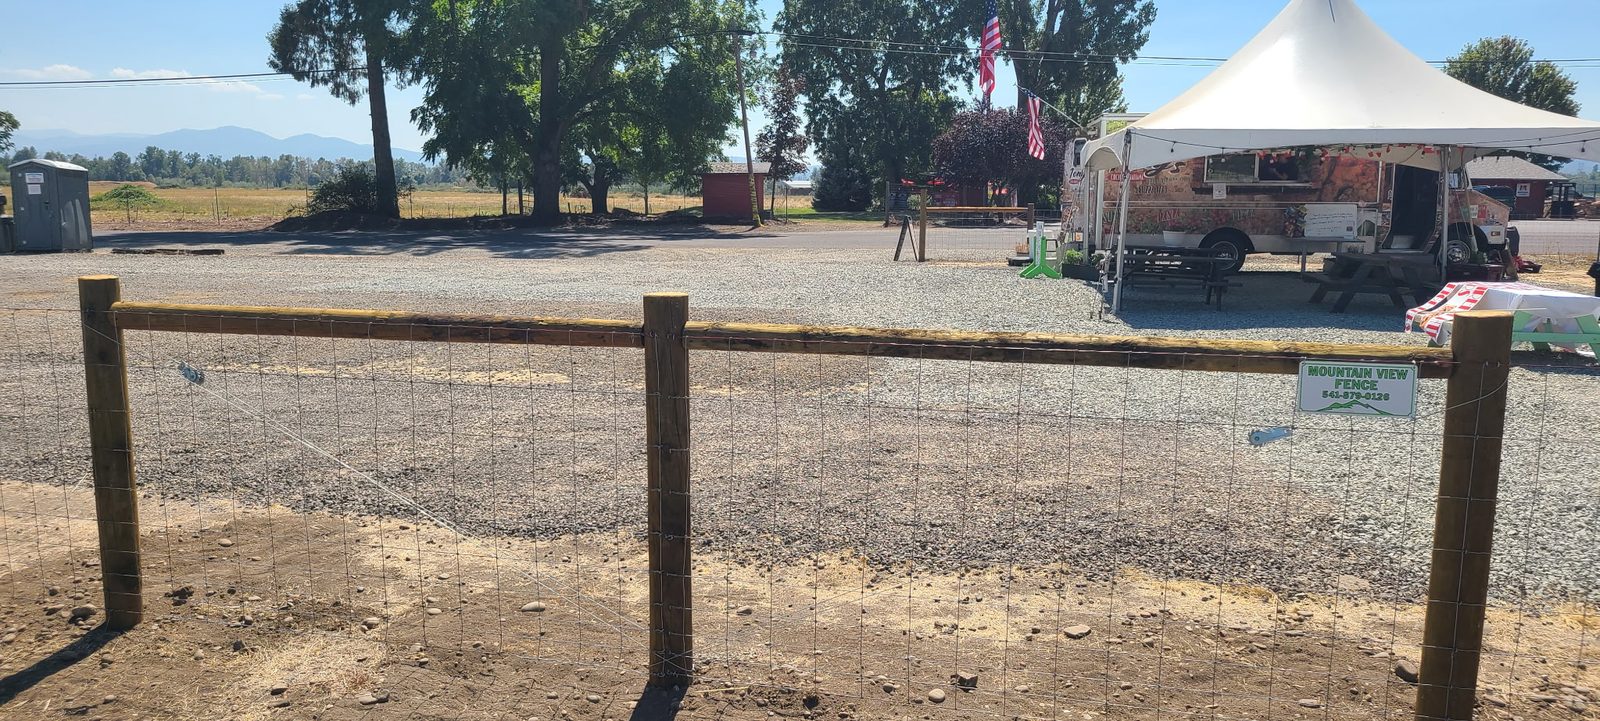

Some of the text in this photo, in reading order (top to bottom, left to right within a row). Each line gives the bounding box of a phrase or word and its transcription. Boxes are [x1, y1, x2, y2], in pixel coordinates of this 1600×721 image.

[1308, 366, 1408, 380] MOUNTAIN VIEW
[1334, 379, 1379, 390] FENCE
